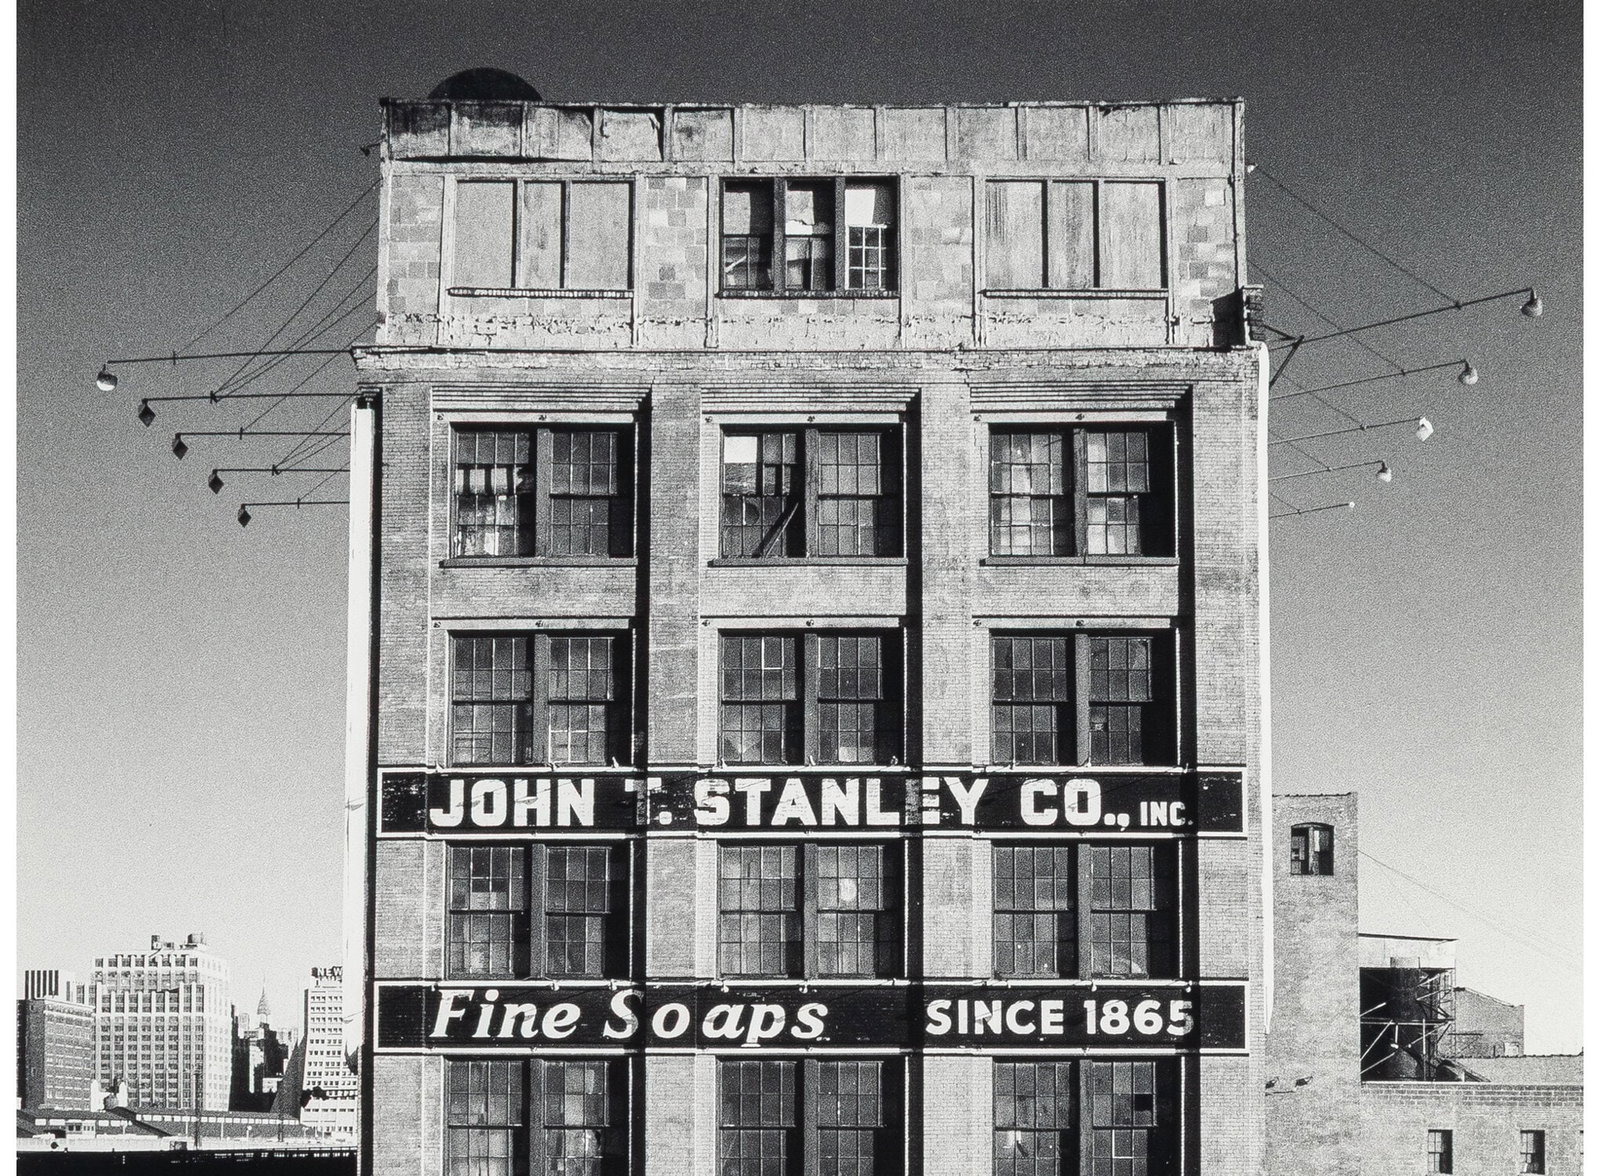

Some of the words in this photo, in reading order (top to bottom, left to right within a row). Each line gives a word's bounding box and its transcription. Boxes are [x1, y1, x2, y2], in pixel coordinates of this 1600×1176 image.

[430, 777, 595, 827] JOHN
[624, 776, 674, 826] T.
[693, 776, 989, 826] STANLEY
[1139, 800, 1194, 826] INC.
[428, 989, 581, 1039] Fine
[603, 989, 829, 1047] Soaps
[925, 999, 1064, 1035] SINCE
[1083, 999, 1195, 1036] 1865
